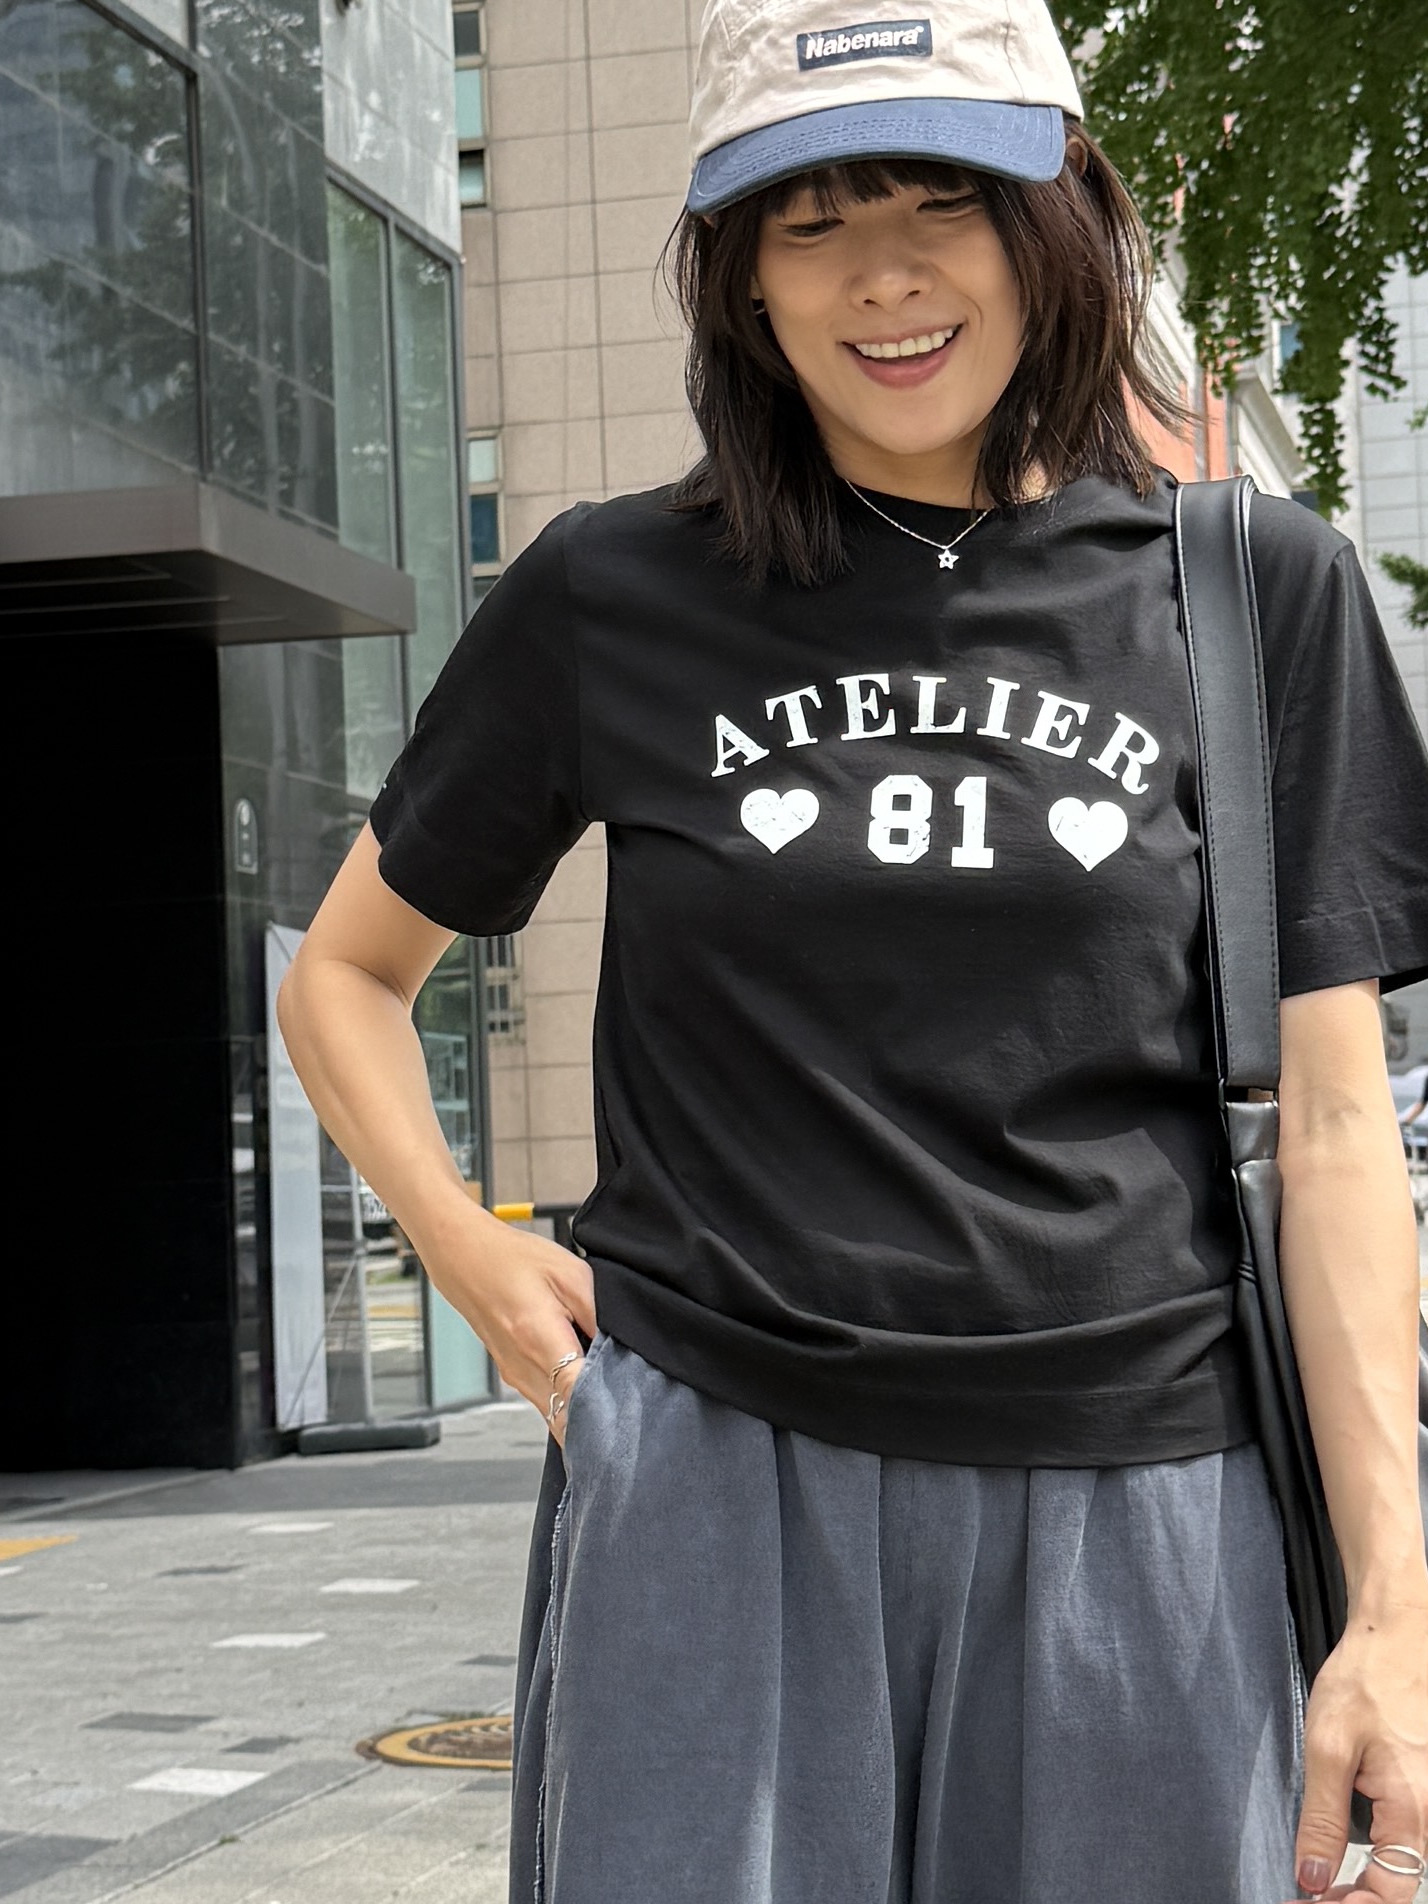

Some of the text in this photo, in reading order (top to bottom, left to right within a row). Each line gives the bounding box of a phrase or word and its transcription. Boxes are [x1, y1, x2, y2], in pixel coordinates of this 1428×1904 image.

[805, 27, 920, 59] Nabenara
[711, 673, 1160, 795] ATELIER
[868, 774, 994, 869] 81
